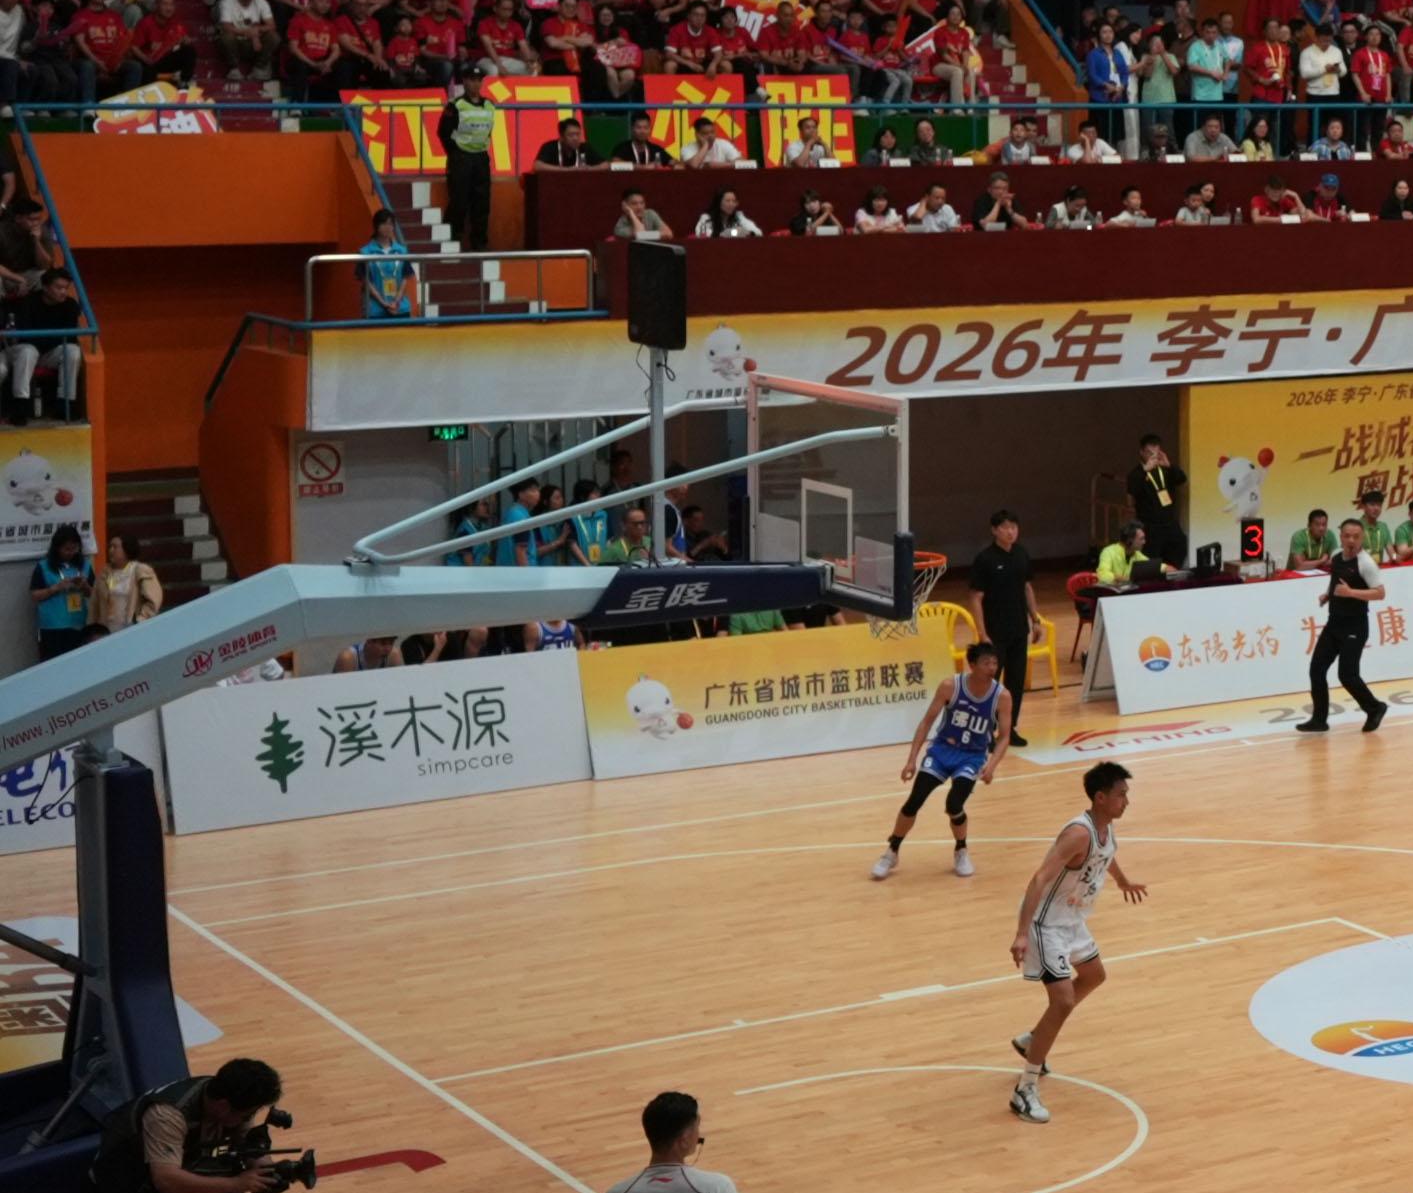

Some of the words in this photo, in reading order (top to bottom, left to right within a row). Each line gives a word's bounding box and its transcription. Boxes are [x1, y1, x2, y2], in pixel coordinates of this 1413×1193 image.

[825, 313, 1122, 387] 2026年
[1287, 389, 1337, 407] 2026年
[1245, 525, 1263, 555] 3
[626, 582, 712, 610] 金陵
[704, 661, 925, 709] 广东省城市篮球联赛
[705, 707, 779, 726] GUANGDONG
[782, 704, 808, 716] CITY
[812, 696, 883, 713] BASKETBALL
[885, 689, 928, 704] LEAGUE
[952, 710, 988, 732] 佛山
[317, 686, 511, 769] 溪木源
[961, 730, 970, 744] 6
[417, 750, 514, 776] simpcare
